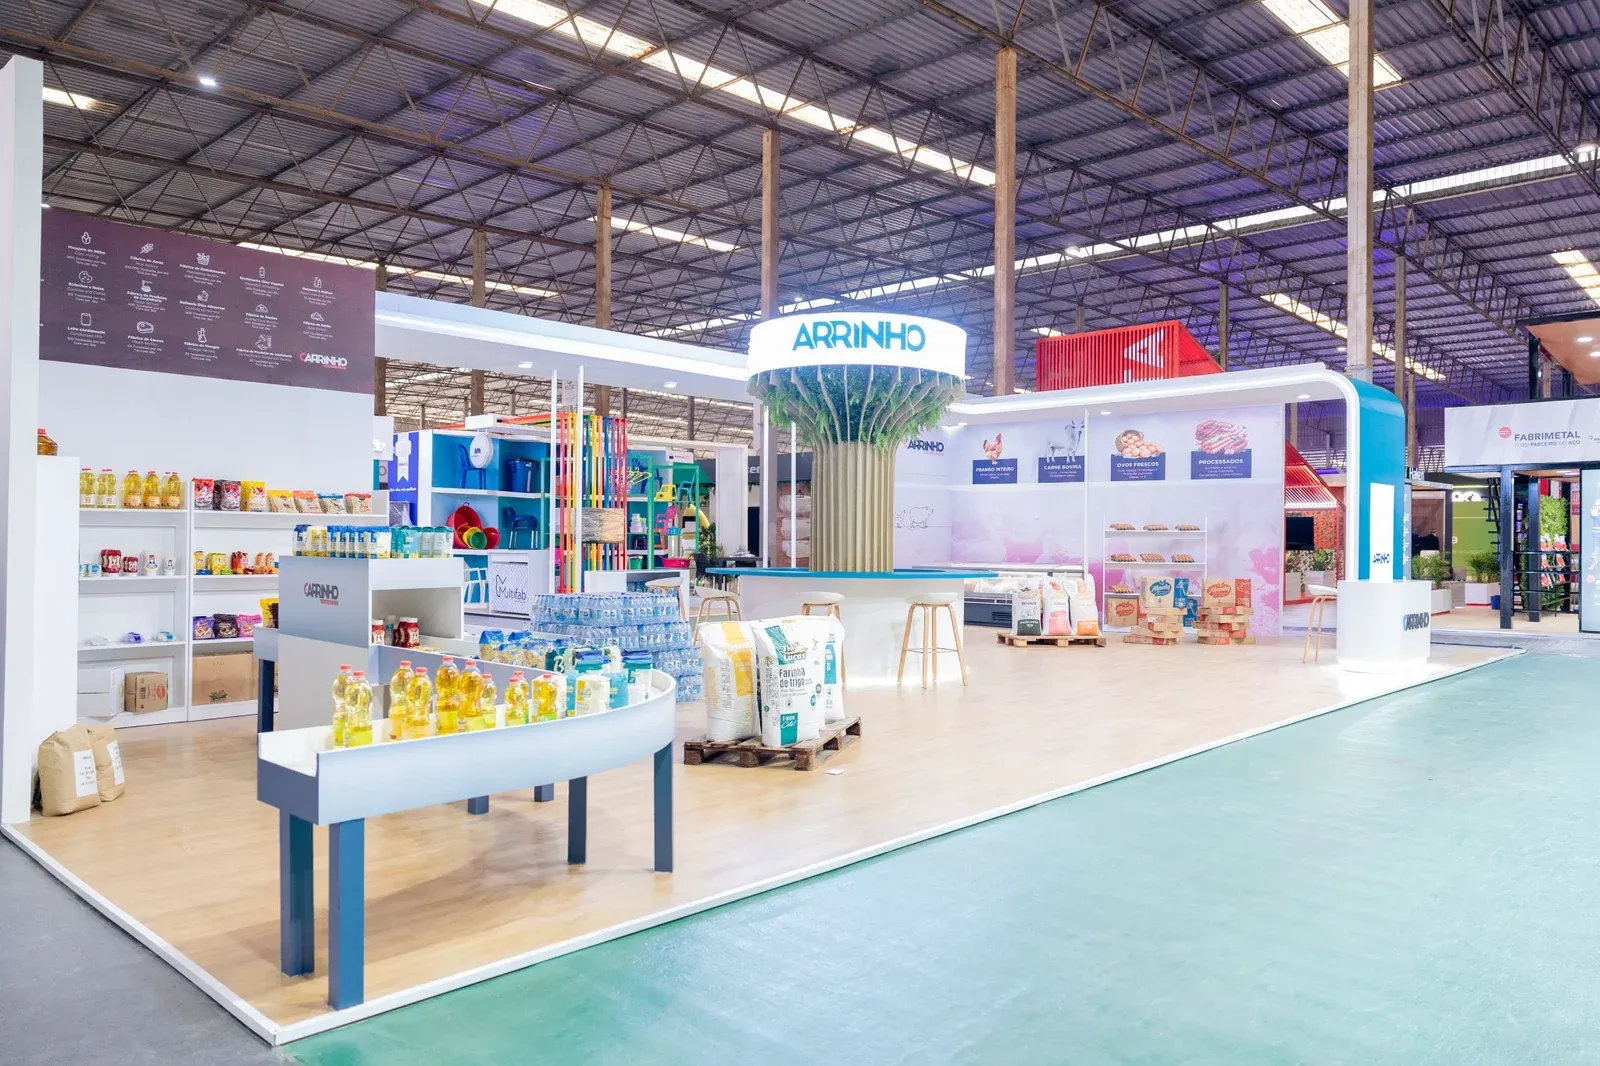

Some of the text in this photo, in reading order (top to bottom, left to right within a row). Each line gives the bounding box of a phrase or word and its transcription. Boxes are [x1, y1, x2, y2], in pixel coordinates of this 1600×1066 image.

[792, 320, 926, 352] ARRINHO
[300, 352, 348, 366] CARRINHO
[1514, 431, 1580, 441] FABRIMETAL
[496, 578, 526, 600] Multifab
[779, 668, 805, 678] Farinha
[780, 678, 804, 688] de trigo
